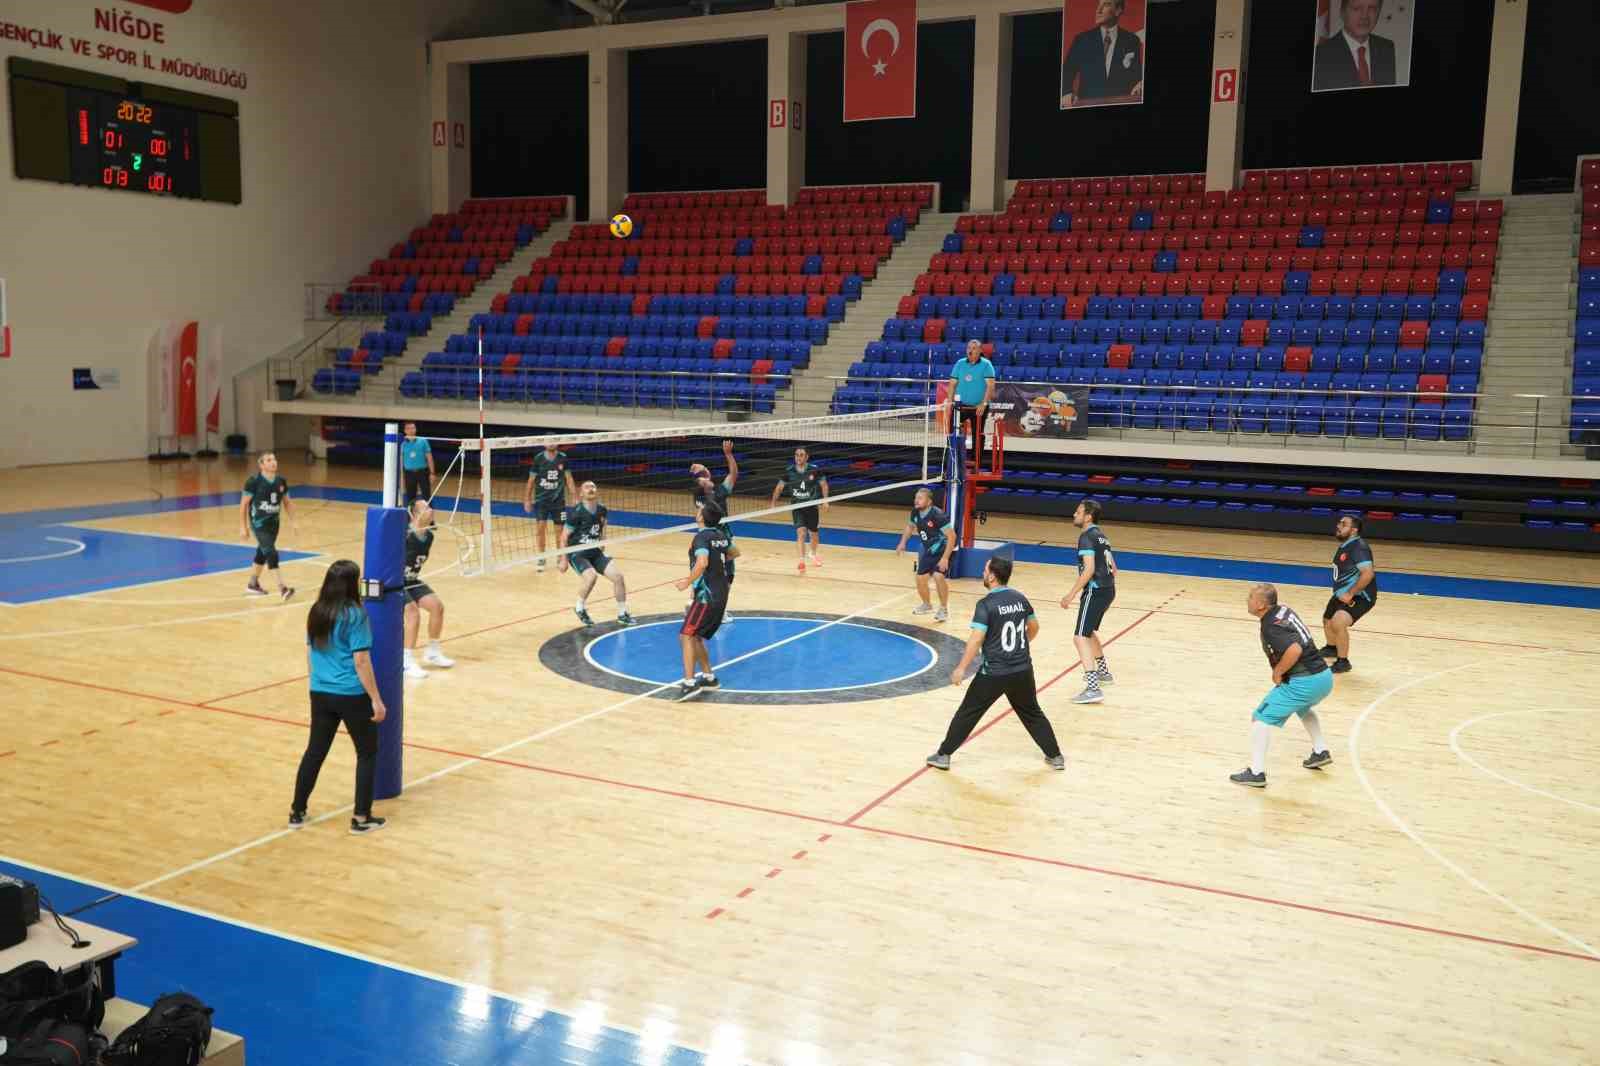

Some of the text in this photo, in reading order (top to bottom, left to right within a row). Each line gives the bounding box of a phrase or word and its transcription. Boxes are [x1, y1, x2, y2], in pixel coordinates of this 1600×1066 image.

[95, 8, 165, 44] NİĞDE
[70, 37, 91, 57] VE
[97, 44, 137, 67] SPOR
[143, 50, 155, 70] İL
[161, 57, 248, 90] MÜDÜRLÜĞÜ
[1219, 73, 1232, 99] C
[773, 102, 783, 127] B
[435, 124, 444, 145] A
[1001, 618, 1025, 652] 01
